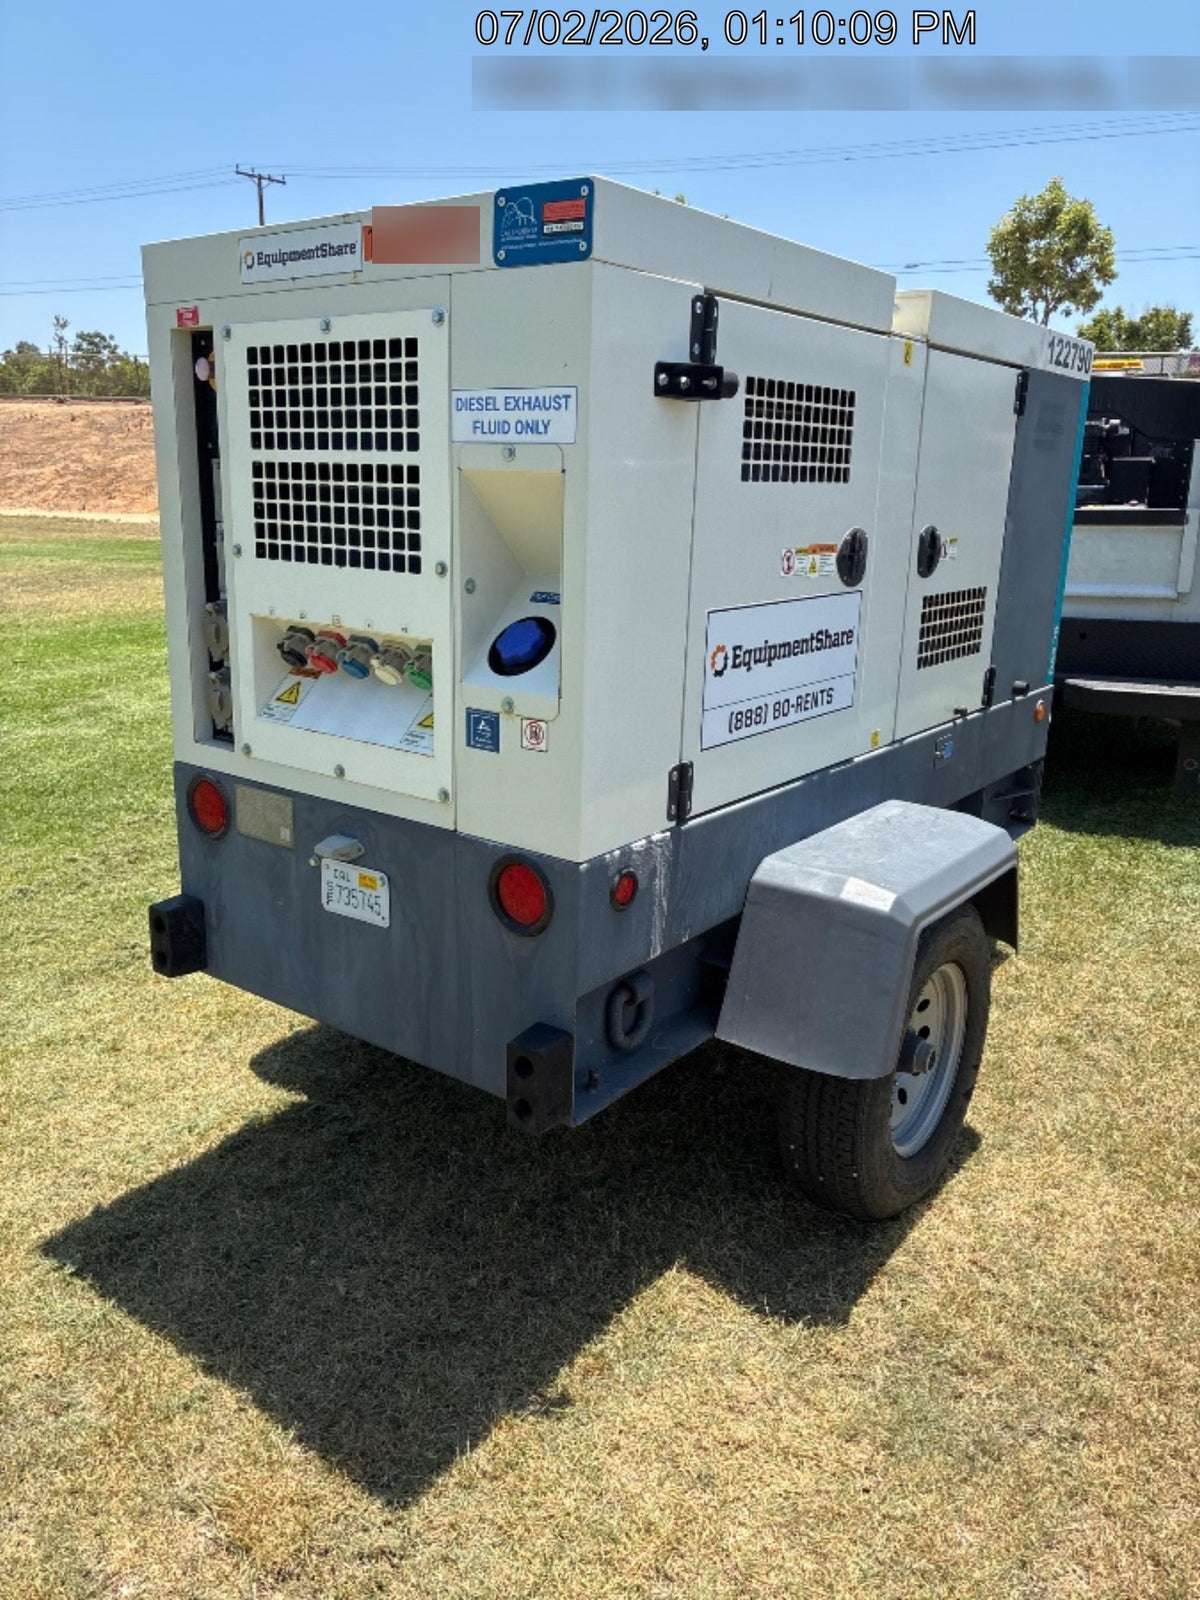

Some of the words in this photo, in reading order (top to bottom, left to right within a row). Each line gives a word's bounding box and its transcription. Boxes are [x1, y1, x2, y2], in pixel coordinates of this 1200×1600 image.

[256, 241, 356, 267] EquipmentShare
[1048, 335, 1092, 374] 122790
[455, 397, 500, 411] DIESEL
[504, 394, 571, 411] EXHAUST
[472, 420, 511, 435] FLUID
[515, 419, 552, 435] ONLY
[731, 628, 855, 672] EquipmentShare
[728, 704, 769, 734] (888)
[772, 687, 835, 721] 80-RENTS
[334, 868, 350, 882] CAL
